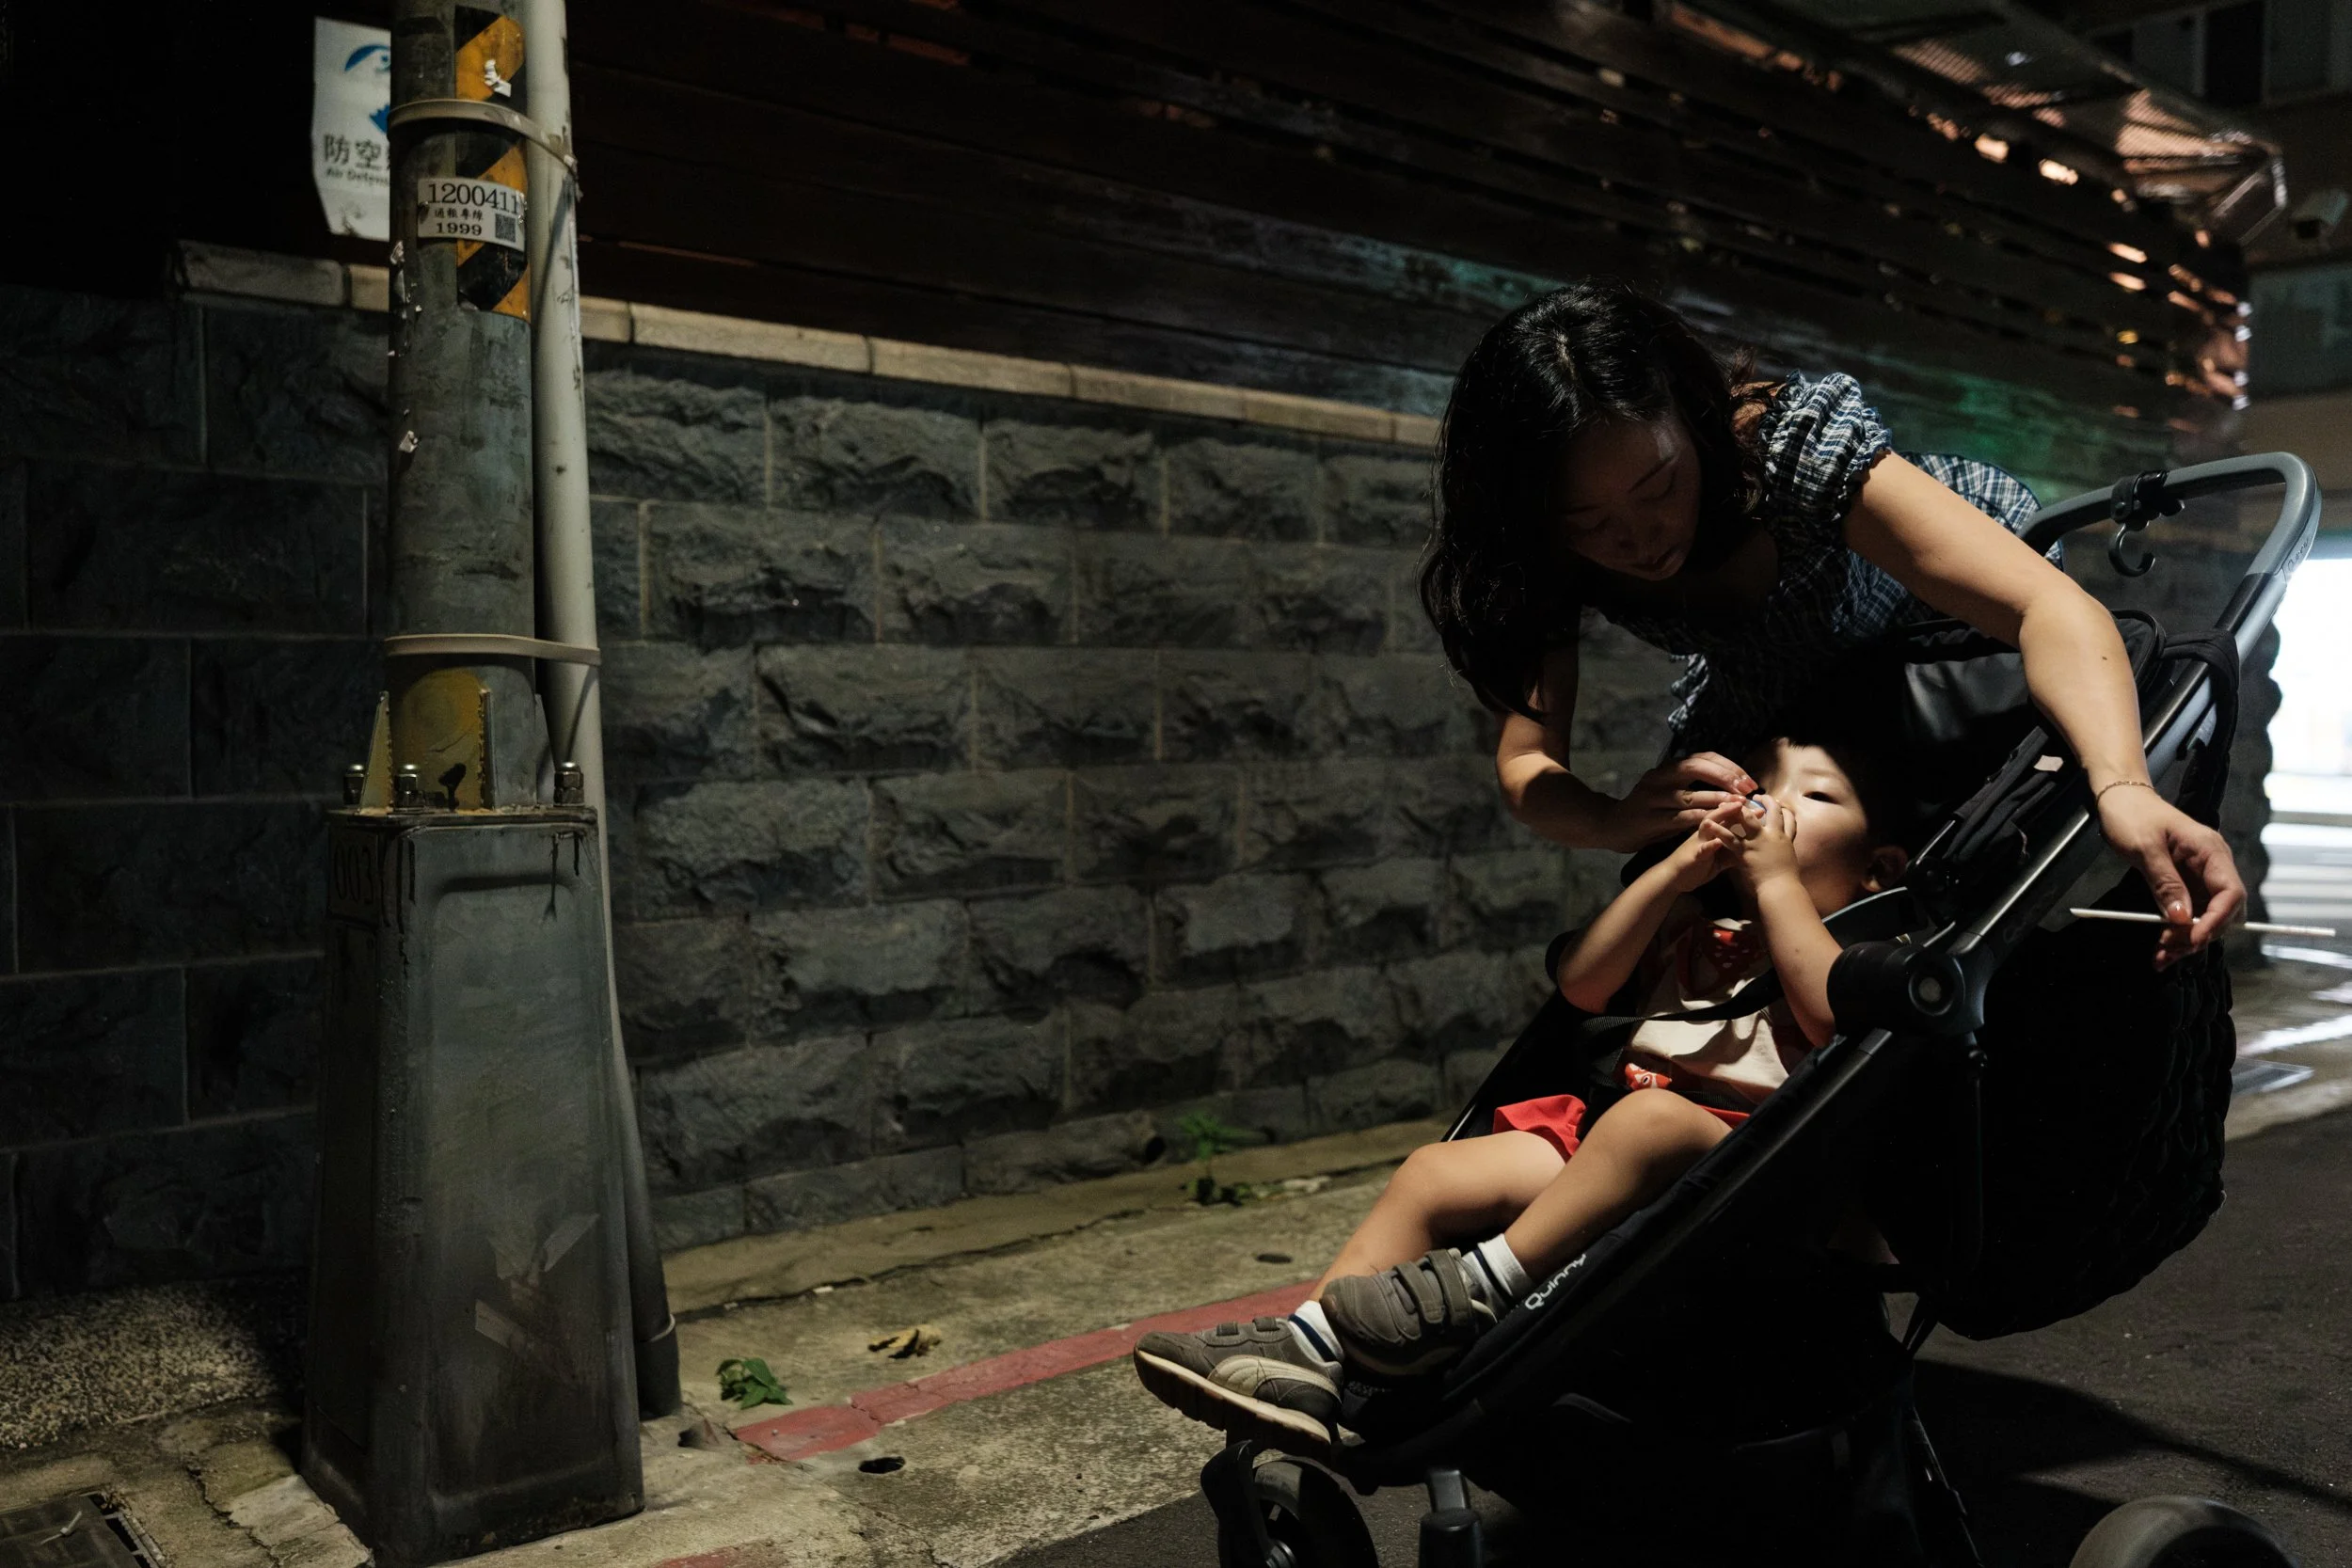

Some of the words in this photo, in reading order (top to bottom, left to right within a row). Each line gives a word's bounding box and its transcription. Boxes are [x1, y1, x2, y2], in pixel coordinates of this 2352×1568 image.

[324, 134, 389, 171] 防空
[427, 182, 518, 215] 1200411
[436, 222, 483, 236] 1999
[1524, 1253, 1587, 1310] Quinny
